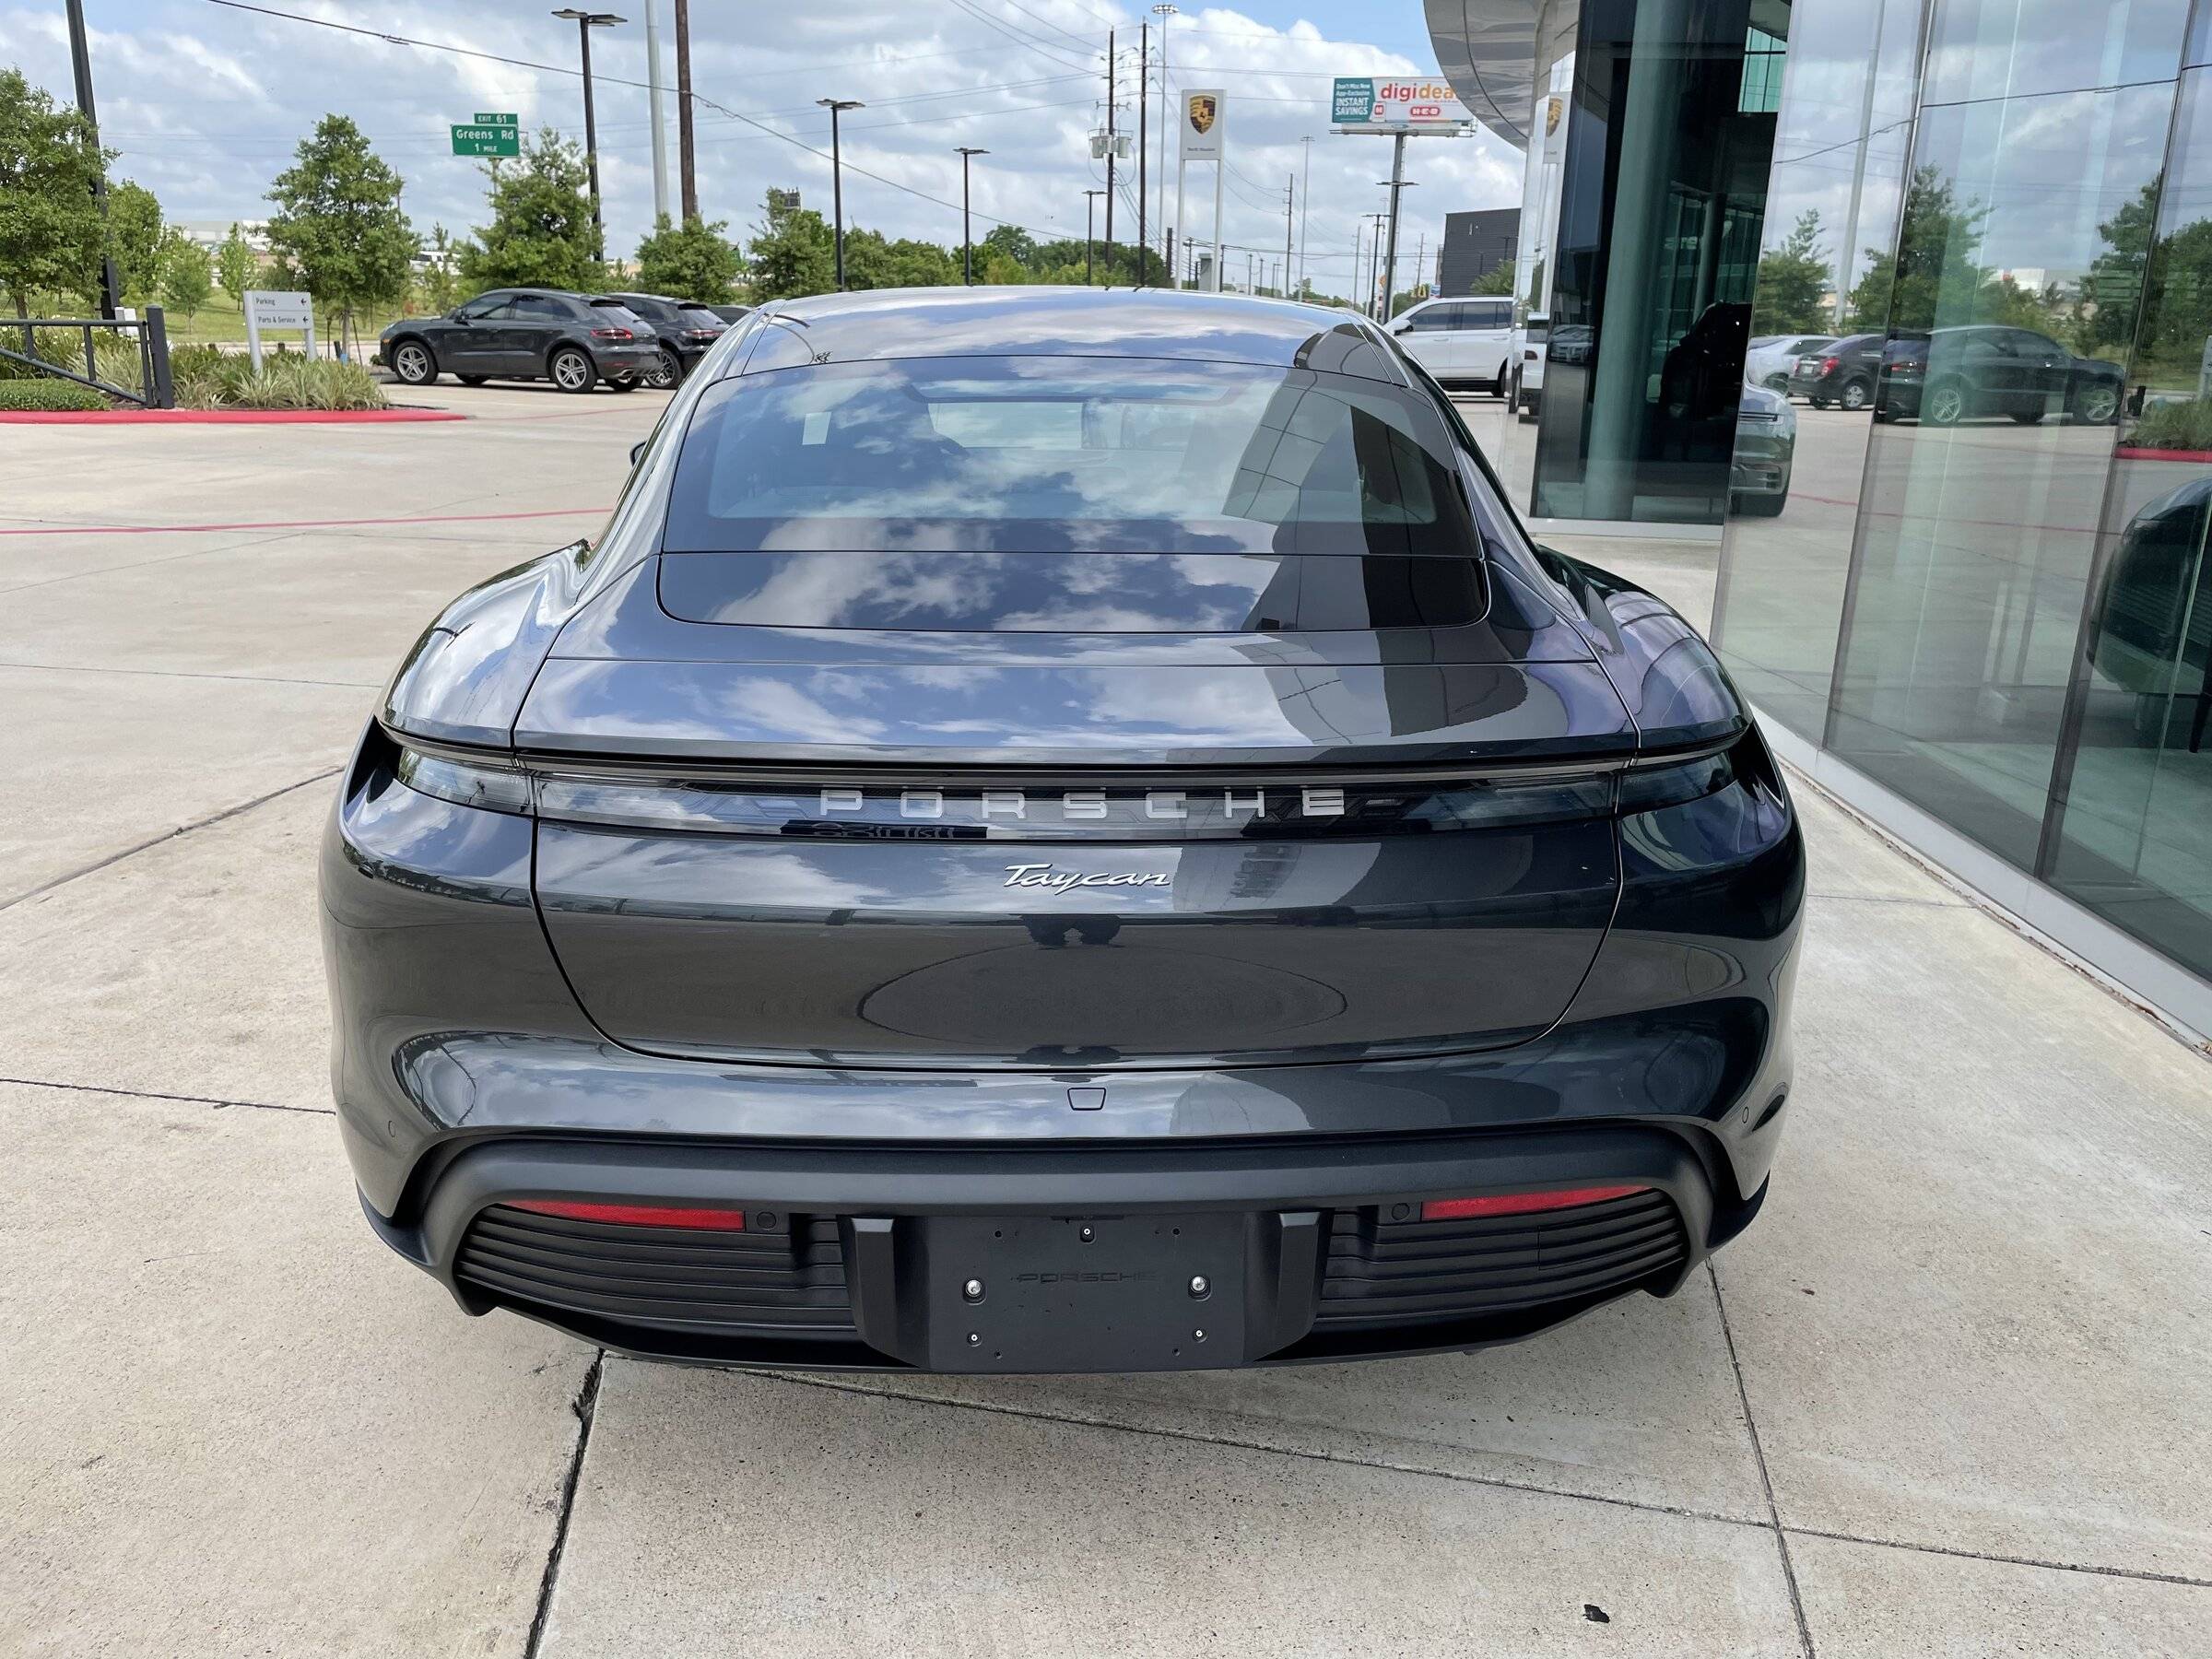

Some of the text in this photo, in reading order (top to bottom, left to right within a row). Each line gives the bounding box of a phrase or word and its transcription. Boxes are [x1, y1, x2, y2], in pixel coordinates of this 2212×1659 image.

[1381, 83, 1457, 101] digidea
[1335, 98, 1370, 107] INSTANT
[1335, 107, 1369, 116] SAVINGS
[496, 115, 508, 124] 61
[456, 129, 514, 140] Greens Rd
[475, 143, 480, 153] 1
[255, 298, 276, 306] Parking
[819, 785, 1346, 819] PORSCHE
[1003, 863, 1171, 896] Taycan
